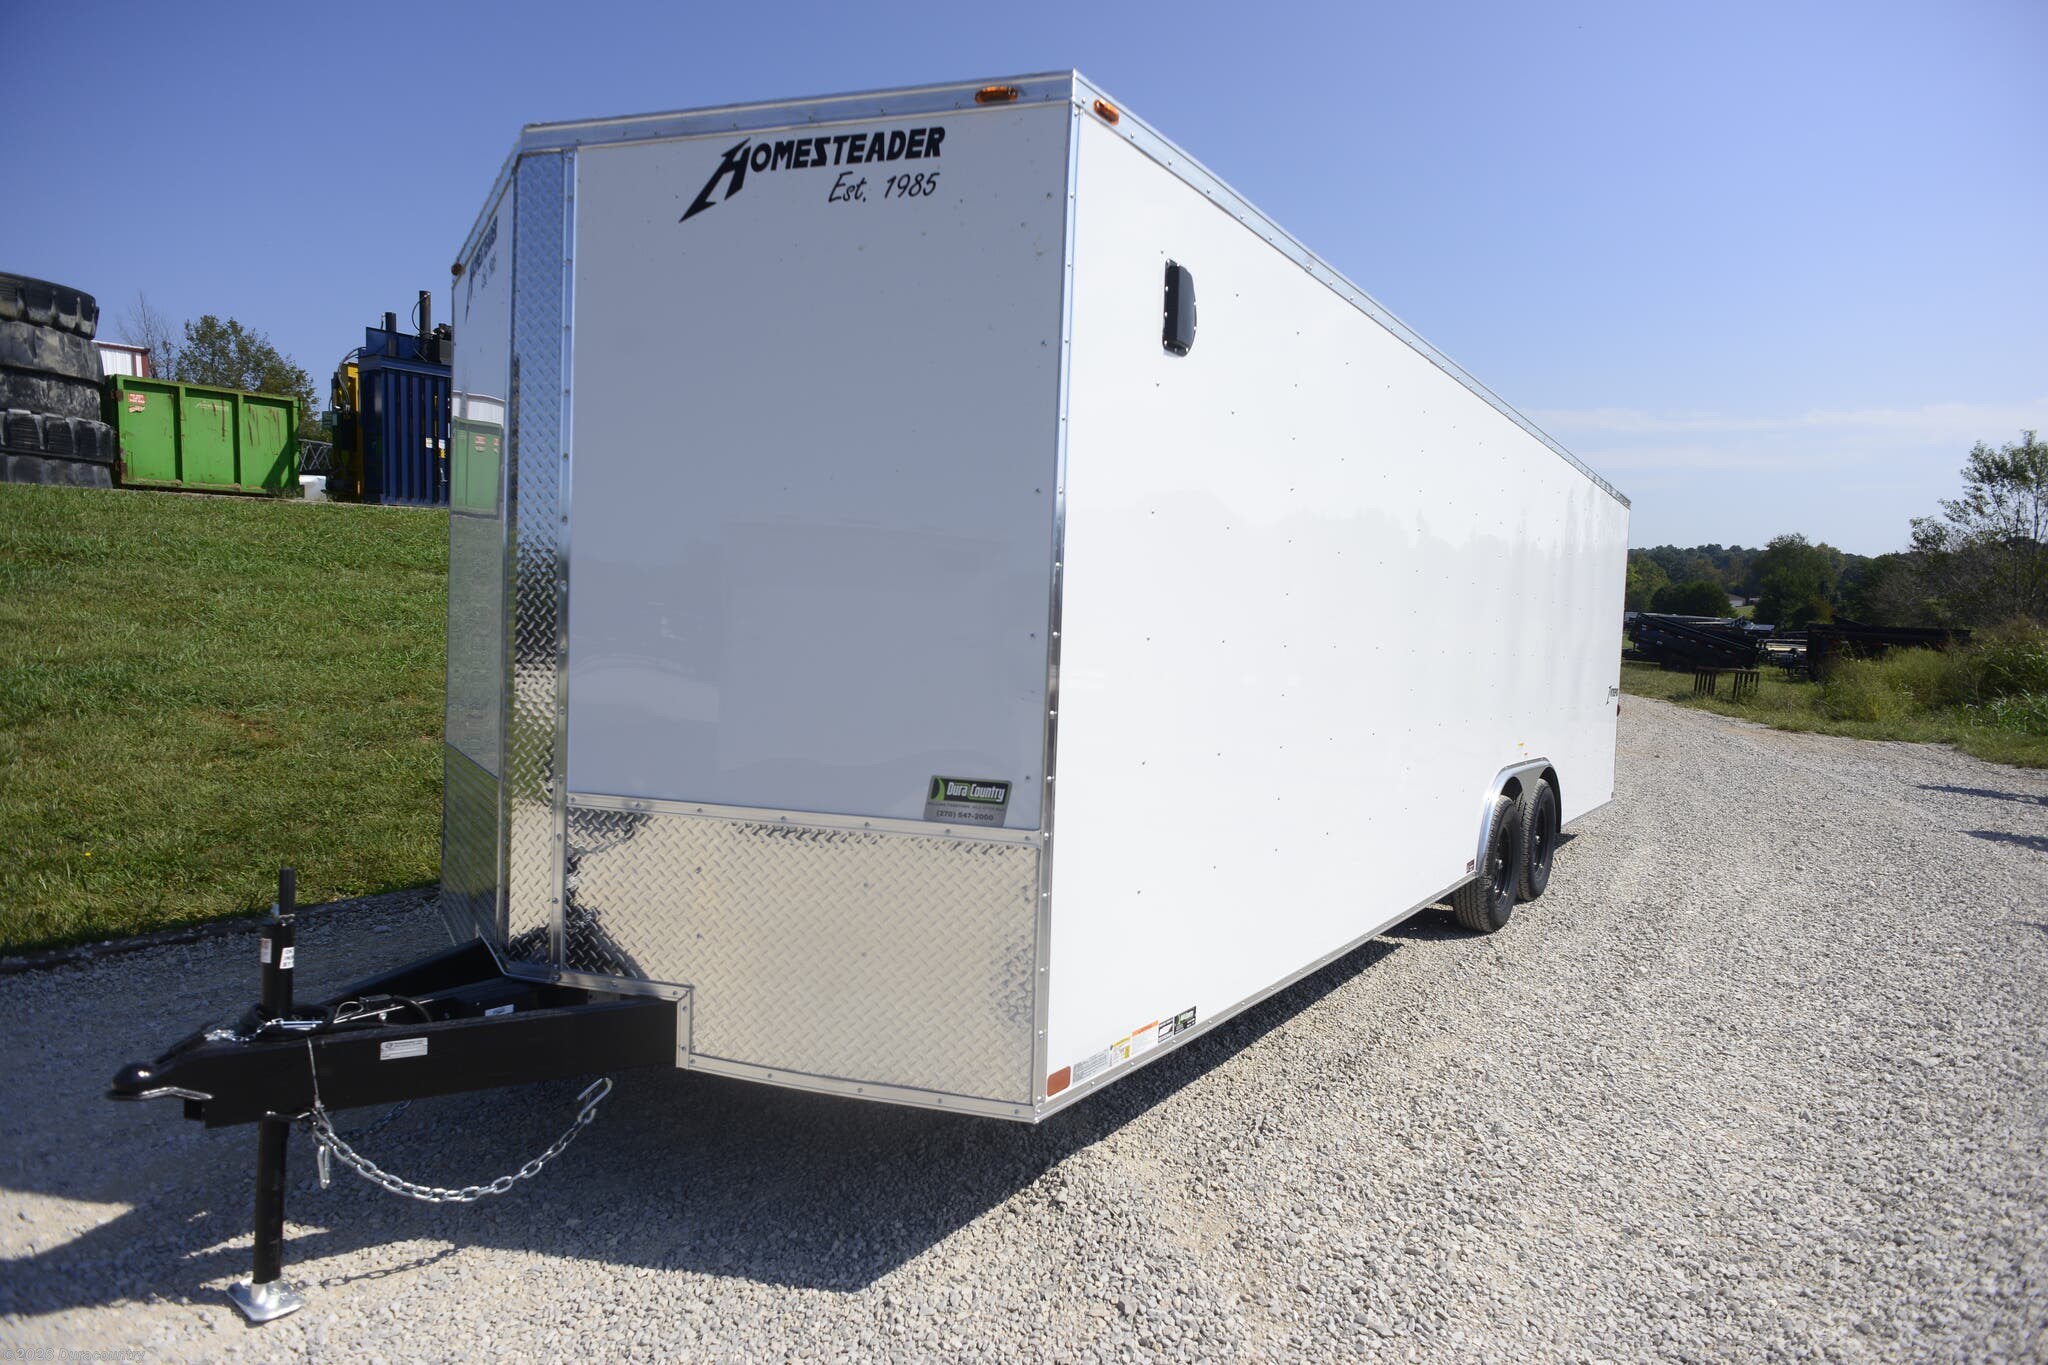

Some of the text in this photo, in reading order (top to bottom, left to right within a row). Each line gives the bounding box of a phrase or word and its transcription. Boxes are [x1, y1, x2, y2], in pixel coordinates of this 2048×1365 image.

[679, 126, 946, 223] HOMESTEADER
[828, 171, 940, 203] Est. 1985
[947, 783, 1005, 802] Dura Country
[937, 810, 955, 819] (270)
